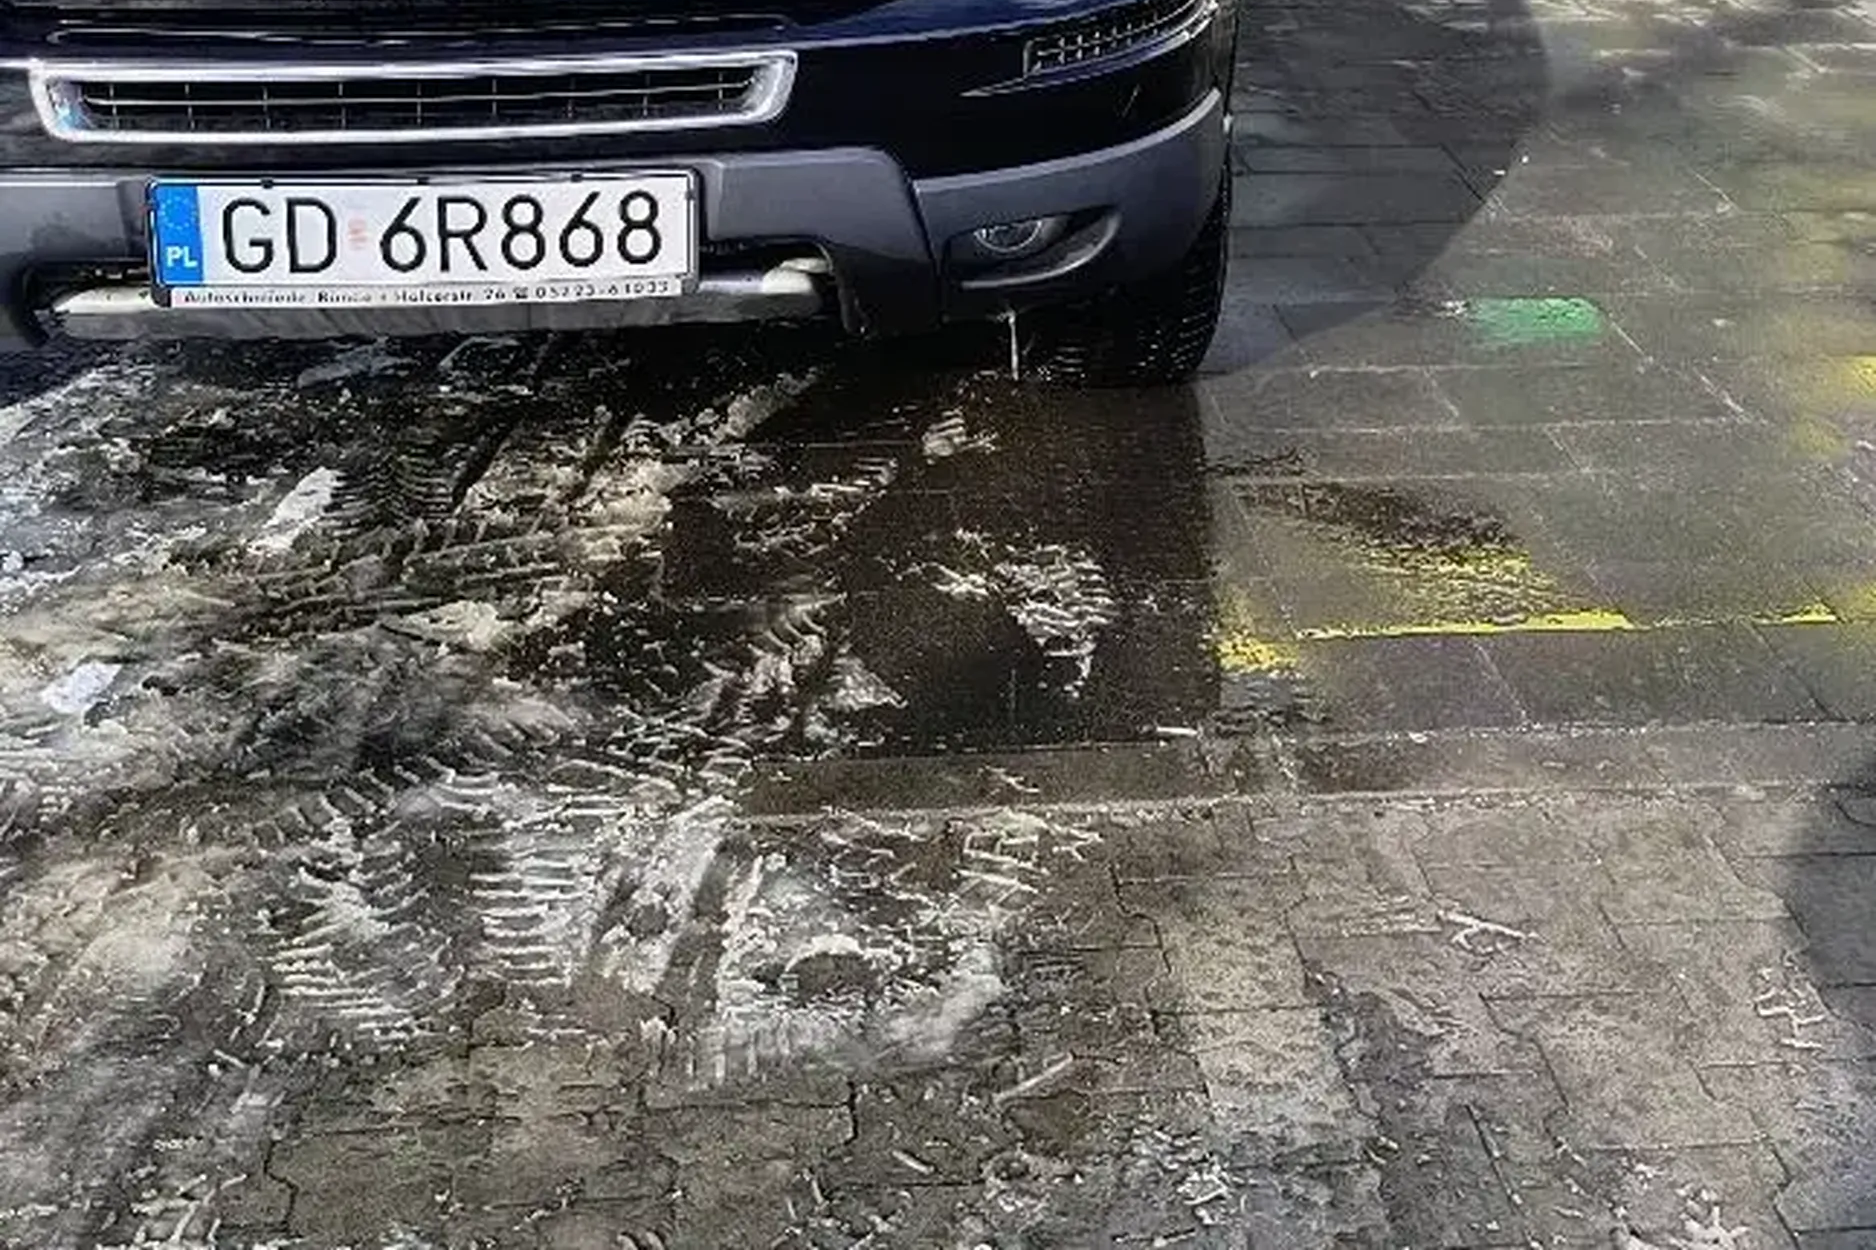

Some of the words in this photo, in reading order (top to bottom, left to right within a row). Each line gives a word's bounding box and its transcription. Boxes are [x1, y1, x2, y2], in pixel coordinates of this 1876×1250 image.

[165, 244, 198, 269] PL
[221, 196, 338, 274] GD
[378, 189, 663, 272] 6R868
